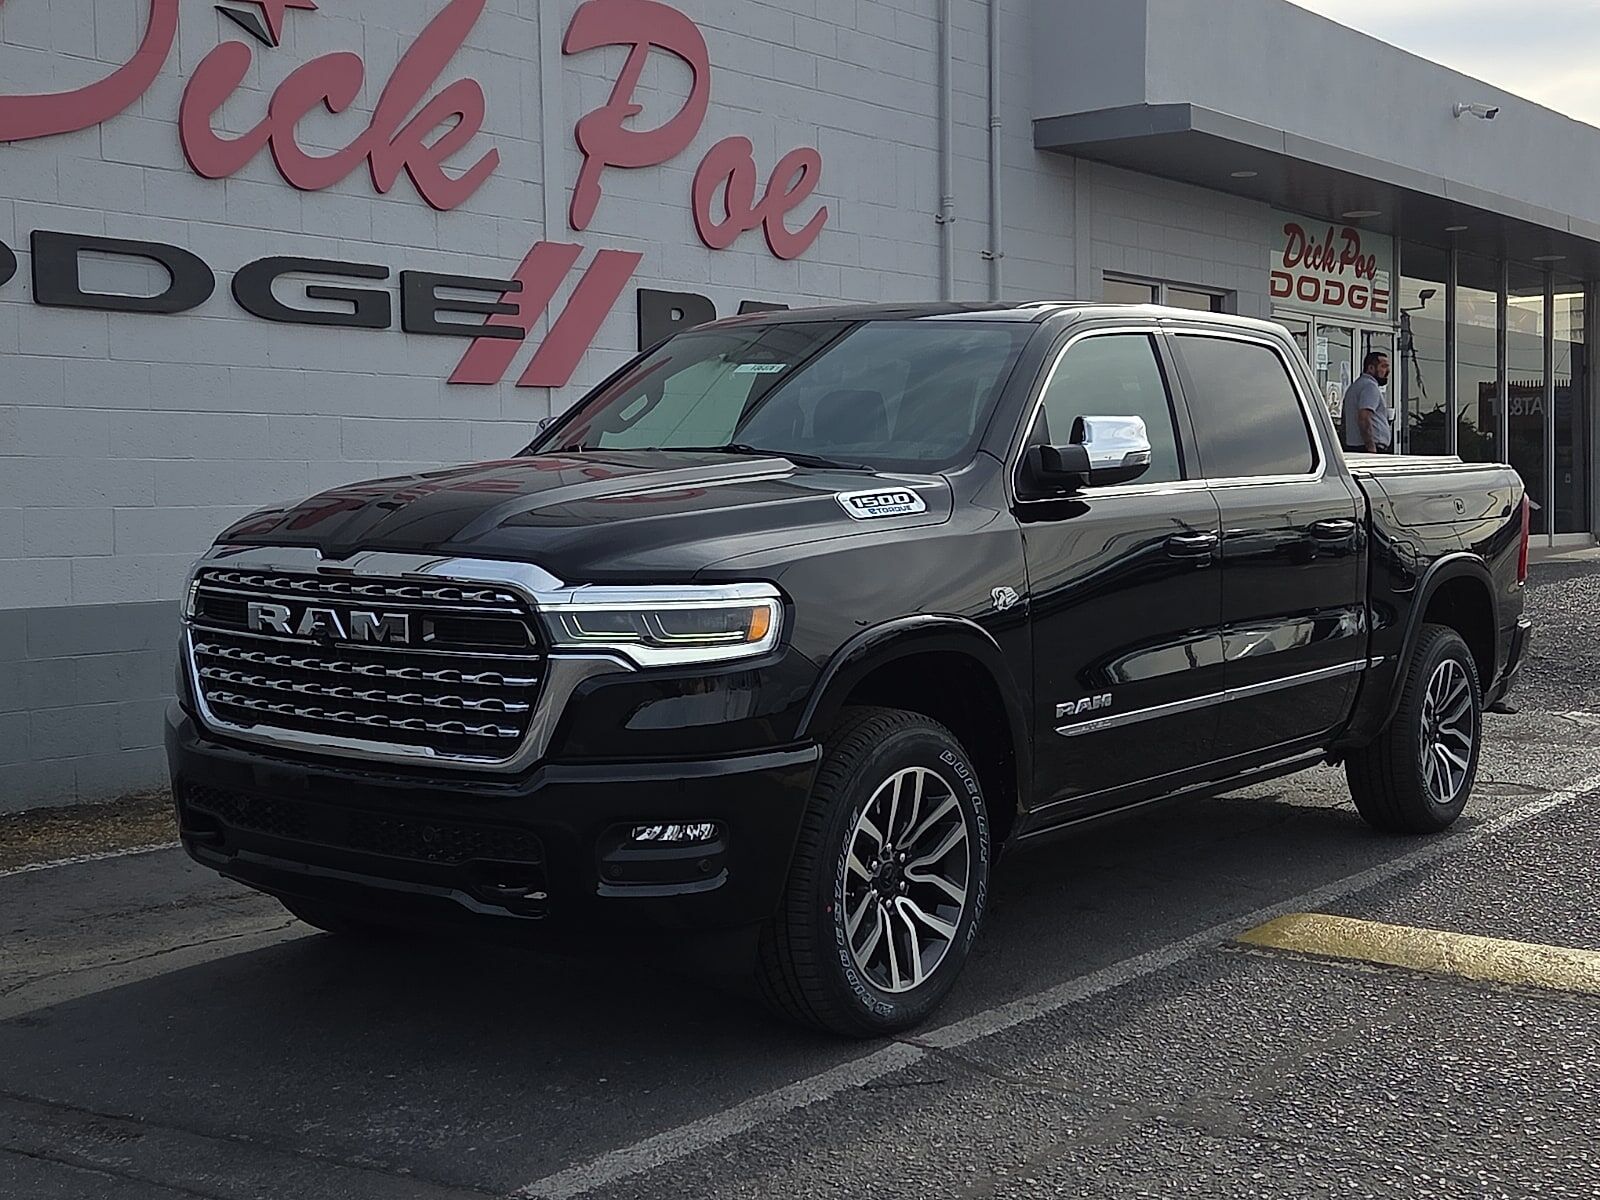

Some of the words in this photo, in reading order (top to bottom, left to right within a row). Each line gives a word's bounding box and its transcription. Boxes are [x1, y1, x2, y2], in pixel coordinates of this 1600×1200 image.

[562, 0, 828, 260] Poe
[1283, 223, 1336, 273] Dick
[1340, 228, 1377, 280] Poe
[0, 229, 525, 340] DGE
[1270, 271, 1389, 313] DODGE
[851, 493, 910, 508] 1500
[247, 601, 410, 643] RAM
[1055, 693, 1112, 718] RAM
[834, 805, 895, 1017] BRIDGESTONE
